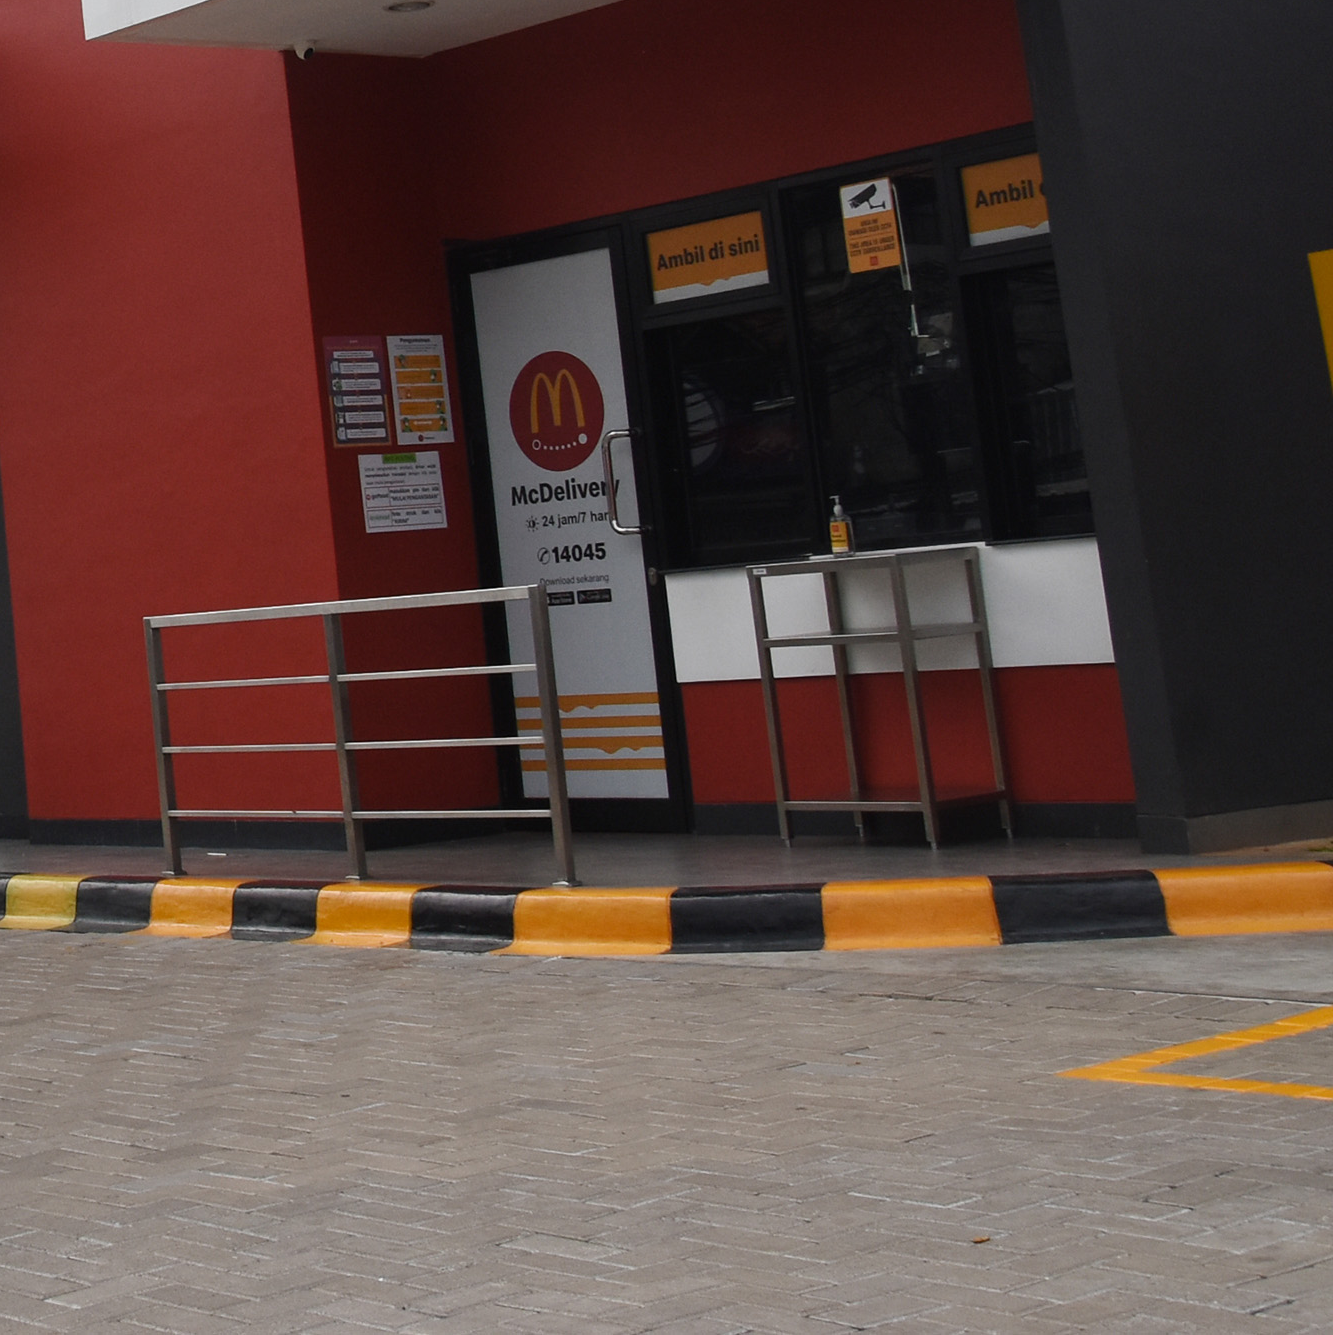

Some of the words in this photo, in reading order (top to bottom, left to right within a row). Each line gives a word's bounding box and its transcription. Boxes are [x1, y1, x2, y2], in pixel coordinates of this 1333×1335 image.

[975, 179, 1035, 209] Ambil
[657, 246, 706, 271] Ambil
[708, 240, 725, 260] di
[729, 234, 760, 257] sini
[541, 514, 555, 527] 24
[557, 511, 587, 528] jam/7
[551, 542, 606, 564] 14045
[539, 575, 575, 585] Download
[576, 574, 610, 584] sekarang
